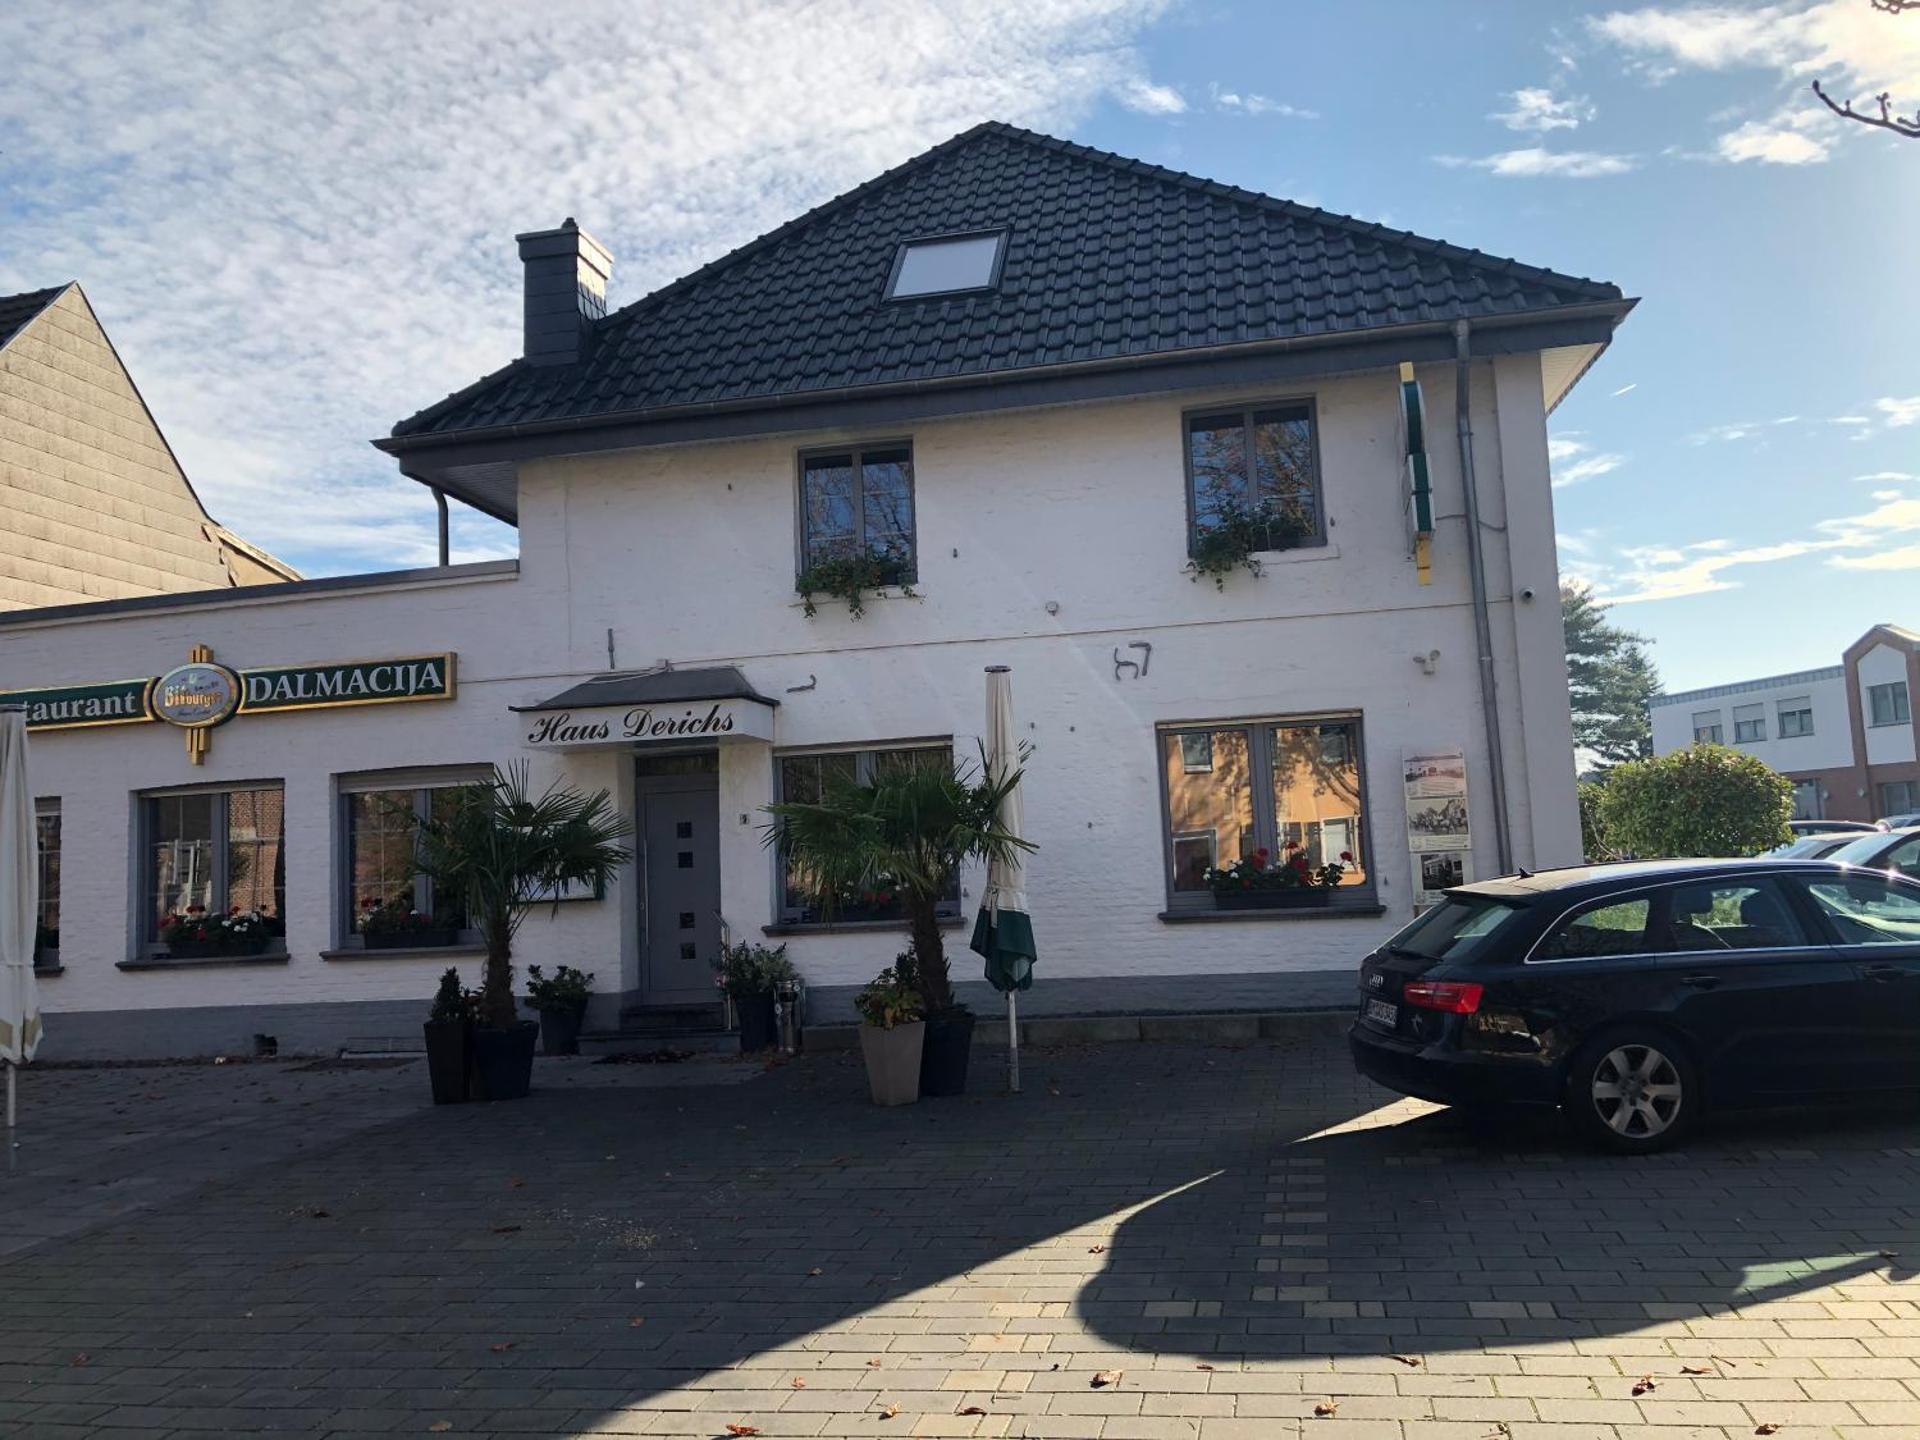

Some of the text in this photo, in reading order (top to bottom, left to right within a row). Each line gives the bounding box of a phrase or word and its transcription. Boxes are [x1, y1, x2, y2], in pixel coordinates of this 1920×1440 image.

[248, 662, 443, 702] DALMACIJA
[24, 691, 137, 722] taurant
[528, 704, 734, 742] Haus Derichs
